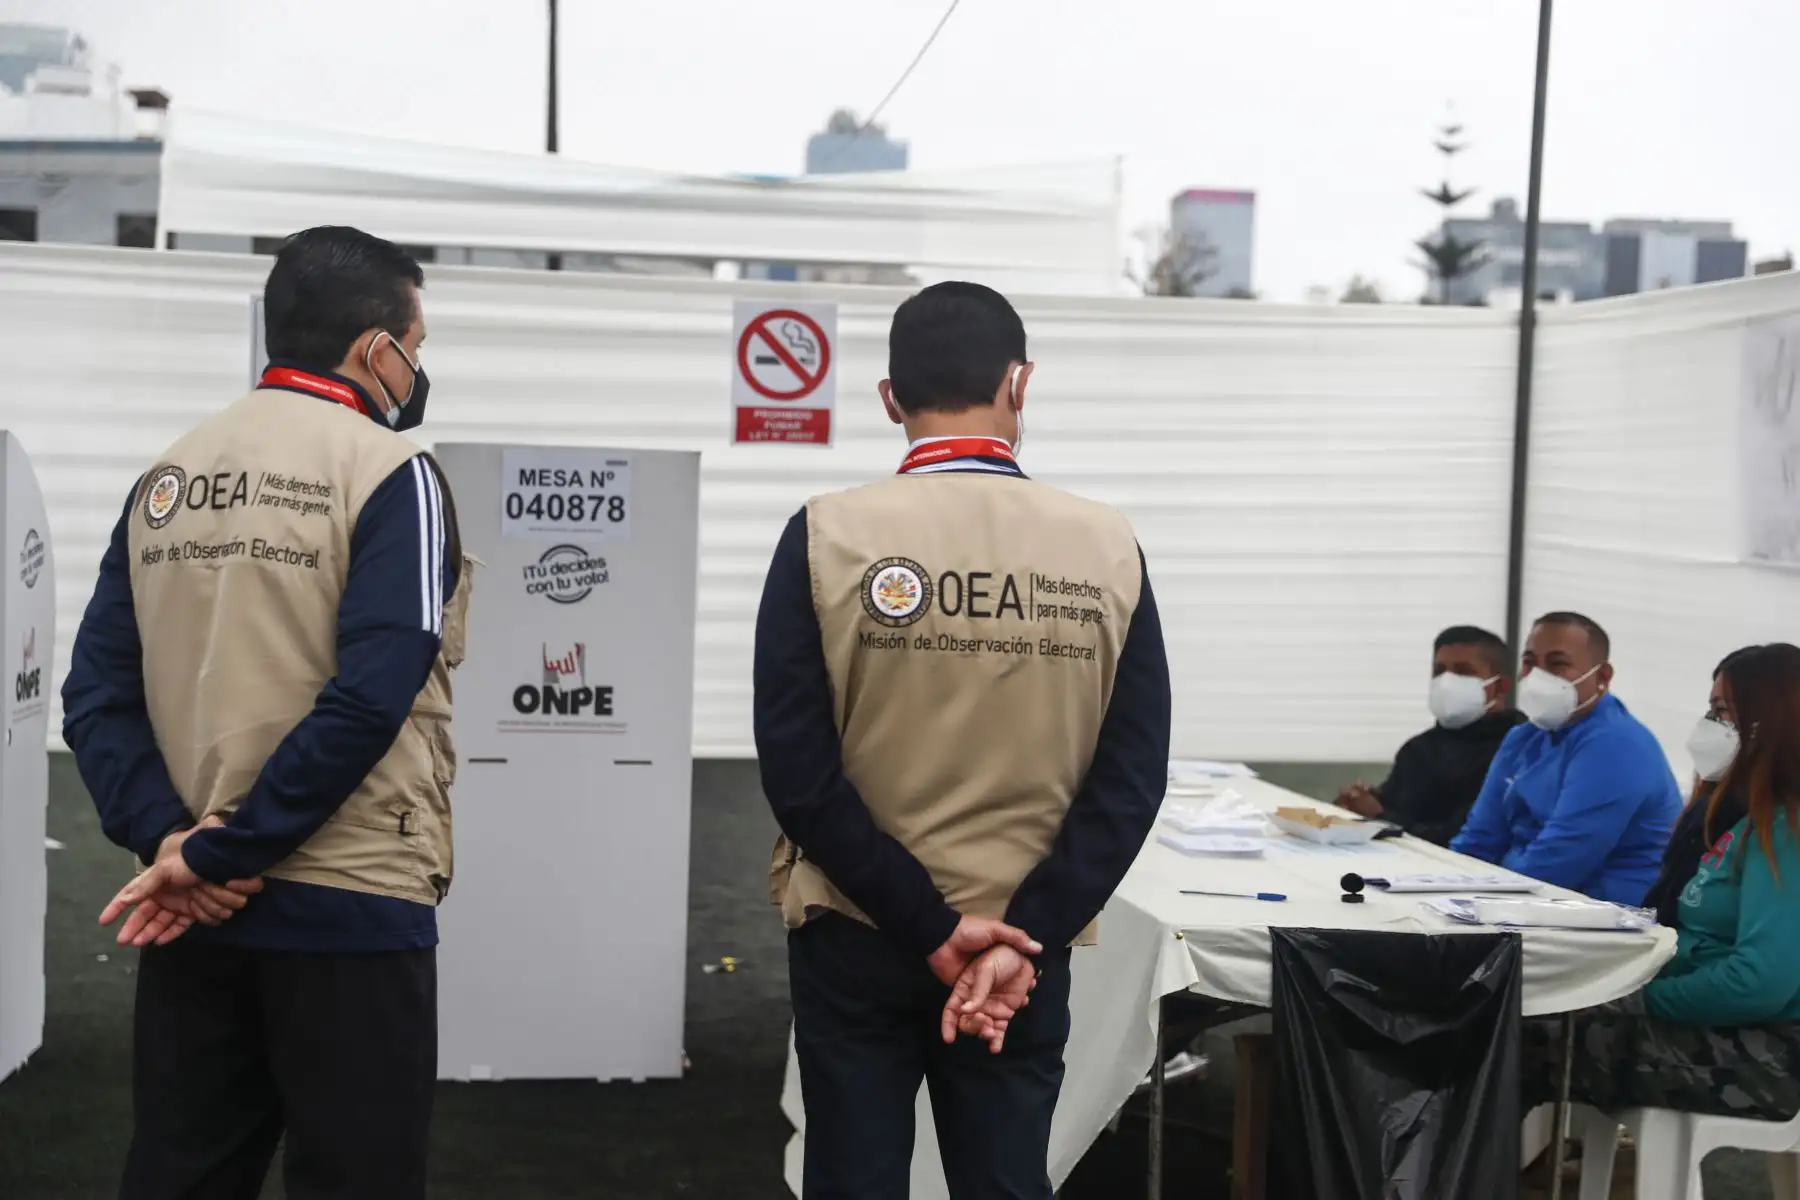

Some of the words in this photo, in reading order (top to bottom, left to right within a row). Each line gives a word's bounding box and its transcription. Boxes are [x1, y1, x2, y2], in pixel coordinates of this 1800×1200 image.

[186, 471, 248, 510] OEA
[264, 472, 286, 491] Más
[286, 475, 332, 498] derechos
[519, 468, 584, 488] MESA
[258, 491, 281, 508] para
[281, 496, 301, 510] más
[301, 502, 330, 517] gente
[506, 492, 625, 523] 040878
[168, 542, 180, 561] de
[251, 538, 320, 570] Electoral
[550, 557, 607, 575] decides
[526, 580, 554, 595] con
[556, 576, 571, 590] tu
[938, 570, 1024, 620] OEA
[1059, 576, 1102, 600] derechos
[1037, 603, 1058, 623] para
[1060, 600, 1078, 621] más
[1080, 607, 1103, 627] gente
[860, 632, 906, 650] Misión
[914, 634, 932, 650] de
[938, 635, 1032, 655] Observación
[1039, 639, 1096, 661] Electoral
[513, 683, 613, 716] ONPE
